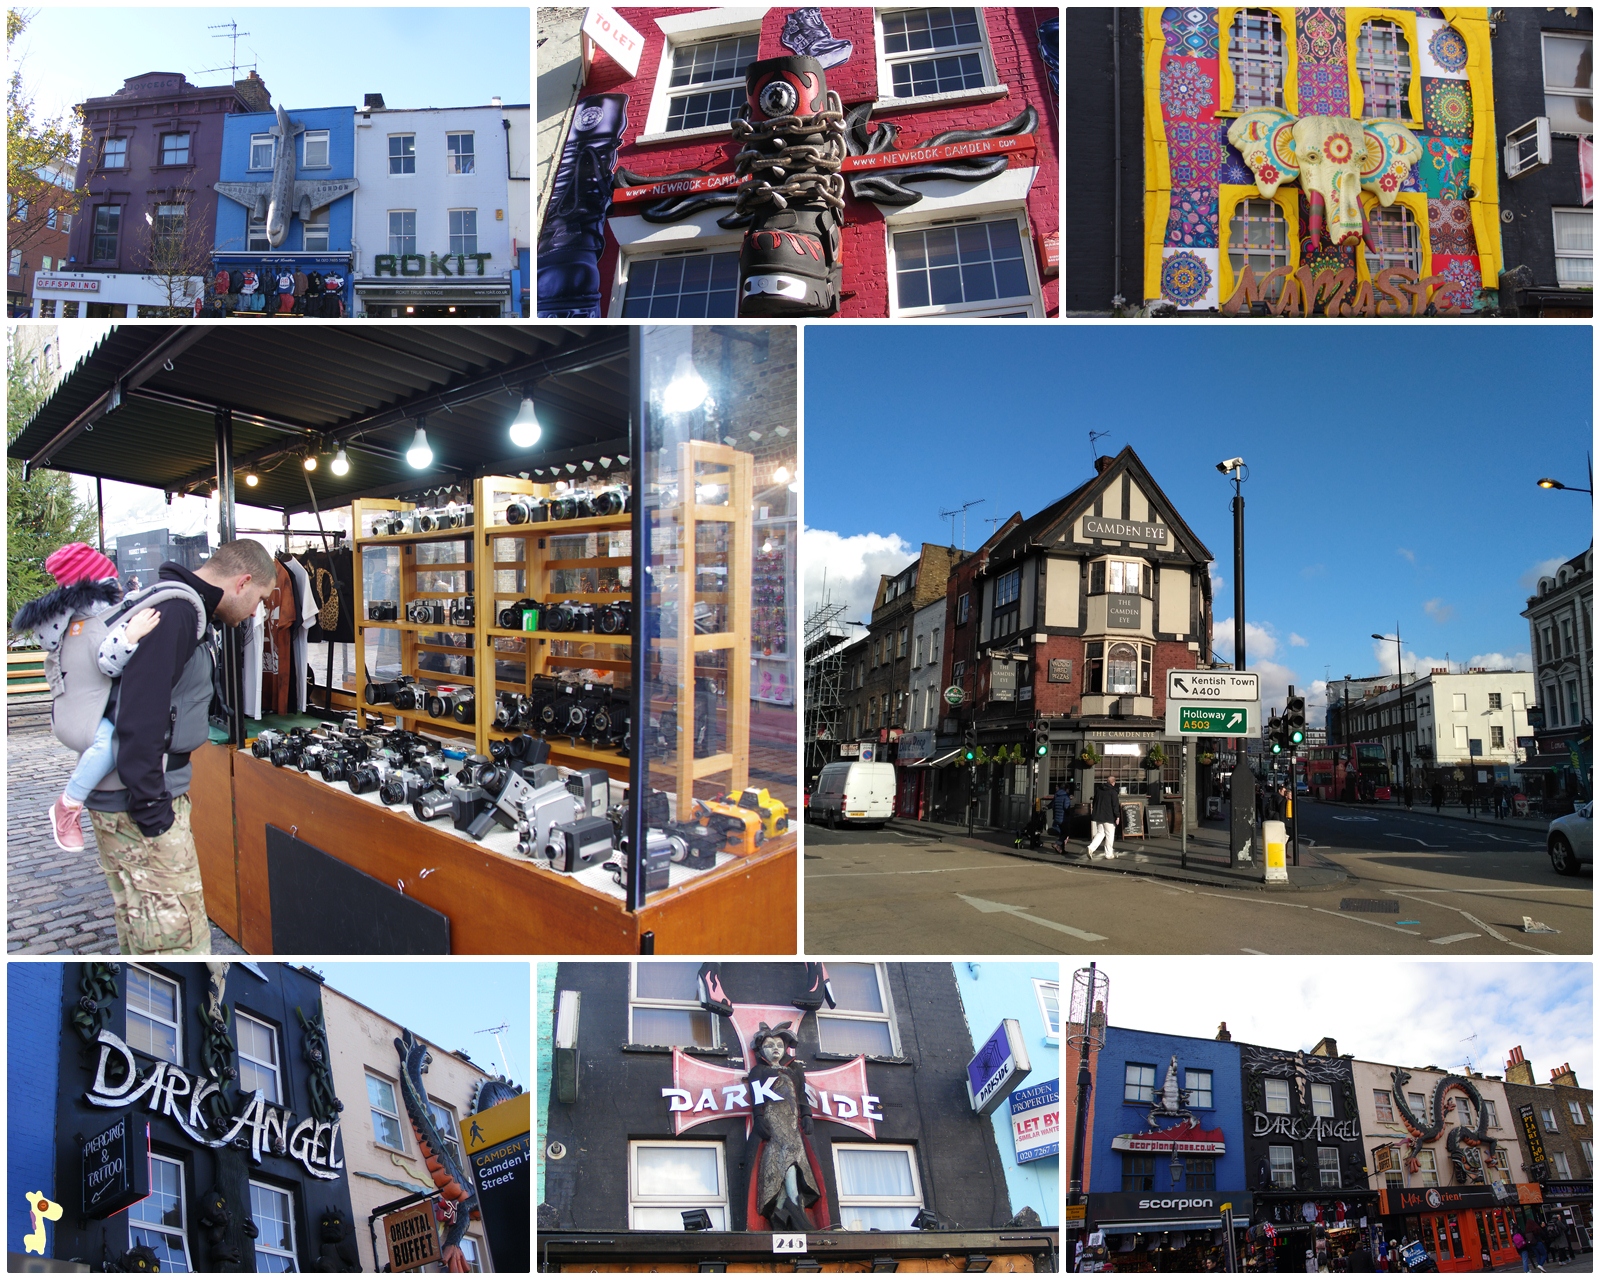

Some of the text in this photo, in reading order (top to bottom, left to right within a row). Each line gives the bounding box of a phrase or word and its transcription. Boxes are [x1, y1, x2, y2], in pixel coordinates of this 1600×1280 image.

[595, 13, 636, 51] TO LET
[317, 184, 349, 193] LONDON
[375, 252, 492, 277] ROKIT
[38, 280, 97, 289] OFFSPRING
[1087, 521, 1165, 539] CAMDEN EYE
[1110, 607, 1139, 615] CAMDEN
[1191, 676, 1255, 686] Kentish Town
[1191, 687, 1220, 696] A400
[1183, 710, 1226, 720] Holloway
[1183, 720, 1210, 729] A503
[980, 1063, 1010, 1102] DARKSIDE
[1015, 1083, 1052, 1101] CAMDEN
[661, 1076, 785, 1112] DARK
[1012, 1092, 1059, 1113] PROPERTIES
[86, 1028, 344, 1180] DARK ANGEL
[1016, 1111, 1059, 1135] LET BY
[1253, 1111, 1360, 1142] DARK ANGEL
[85, 1121, 125, 1158] PIERCING
[1018, 1131, 1041, 1142] SIMILAR
[101, 1148, 110, 1162] &
[476, 1142, 522, 1167] CAMDEN
[1020, 1150, 1033, 1160] 020
[1034, 1146, 1050, 1157] 7267
[1129, 1141, 1216, 1152] scorpionsoes.co.uk
[87, 1157, 123, 1188] TATTOO
[479, 1155, 522, 1178] Camden
[481, 1171, 515, 1191] Street
[1139, 1198, 1213, 1211] scorpion
[390, 1213, 431, 1242] ORIENTAL
[393, 1233, 434, 1268] BUFFET
[775, 1238, 804, 1248] 245
